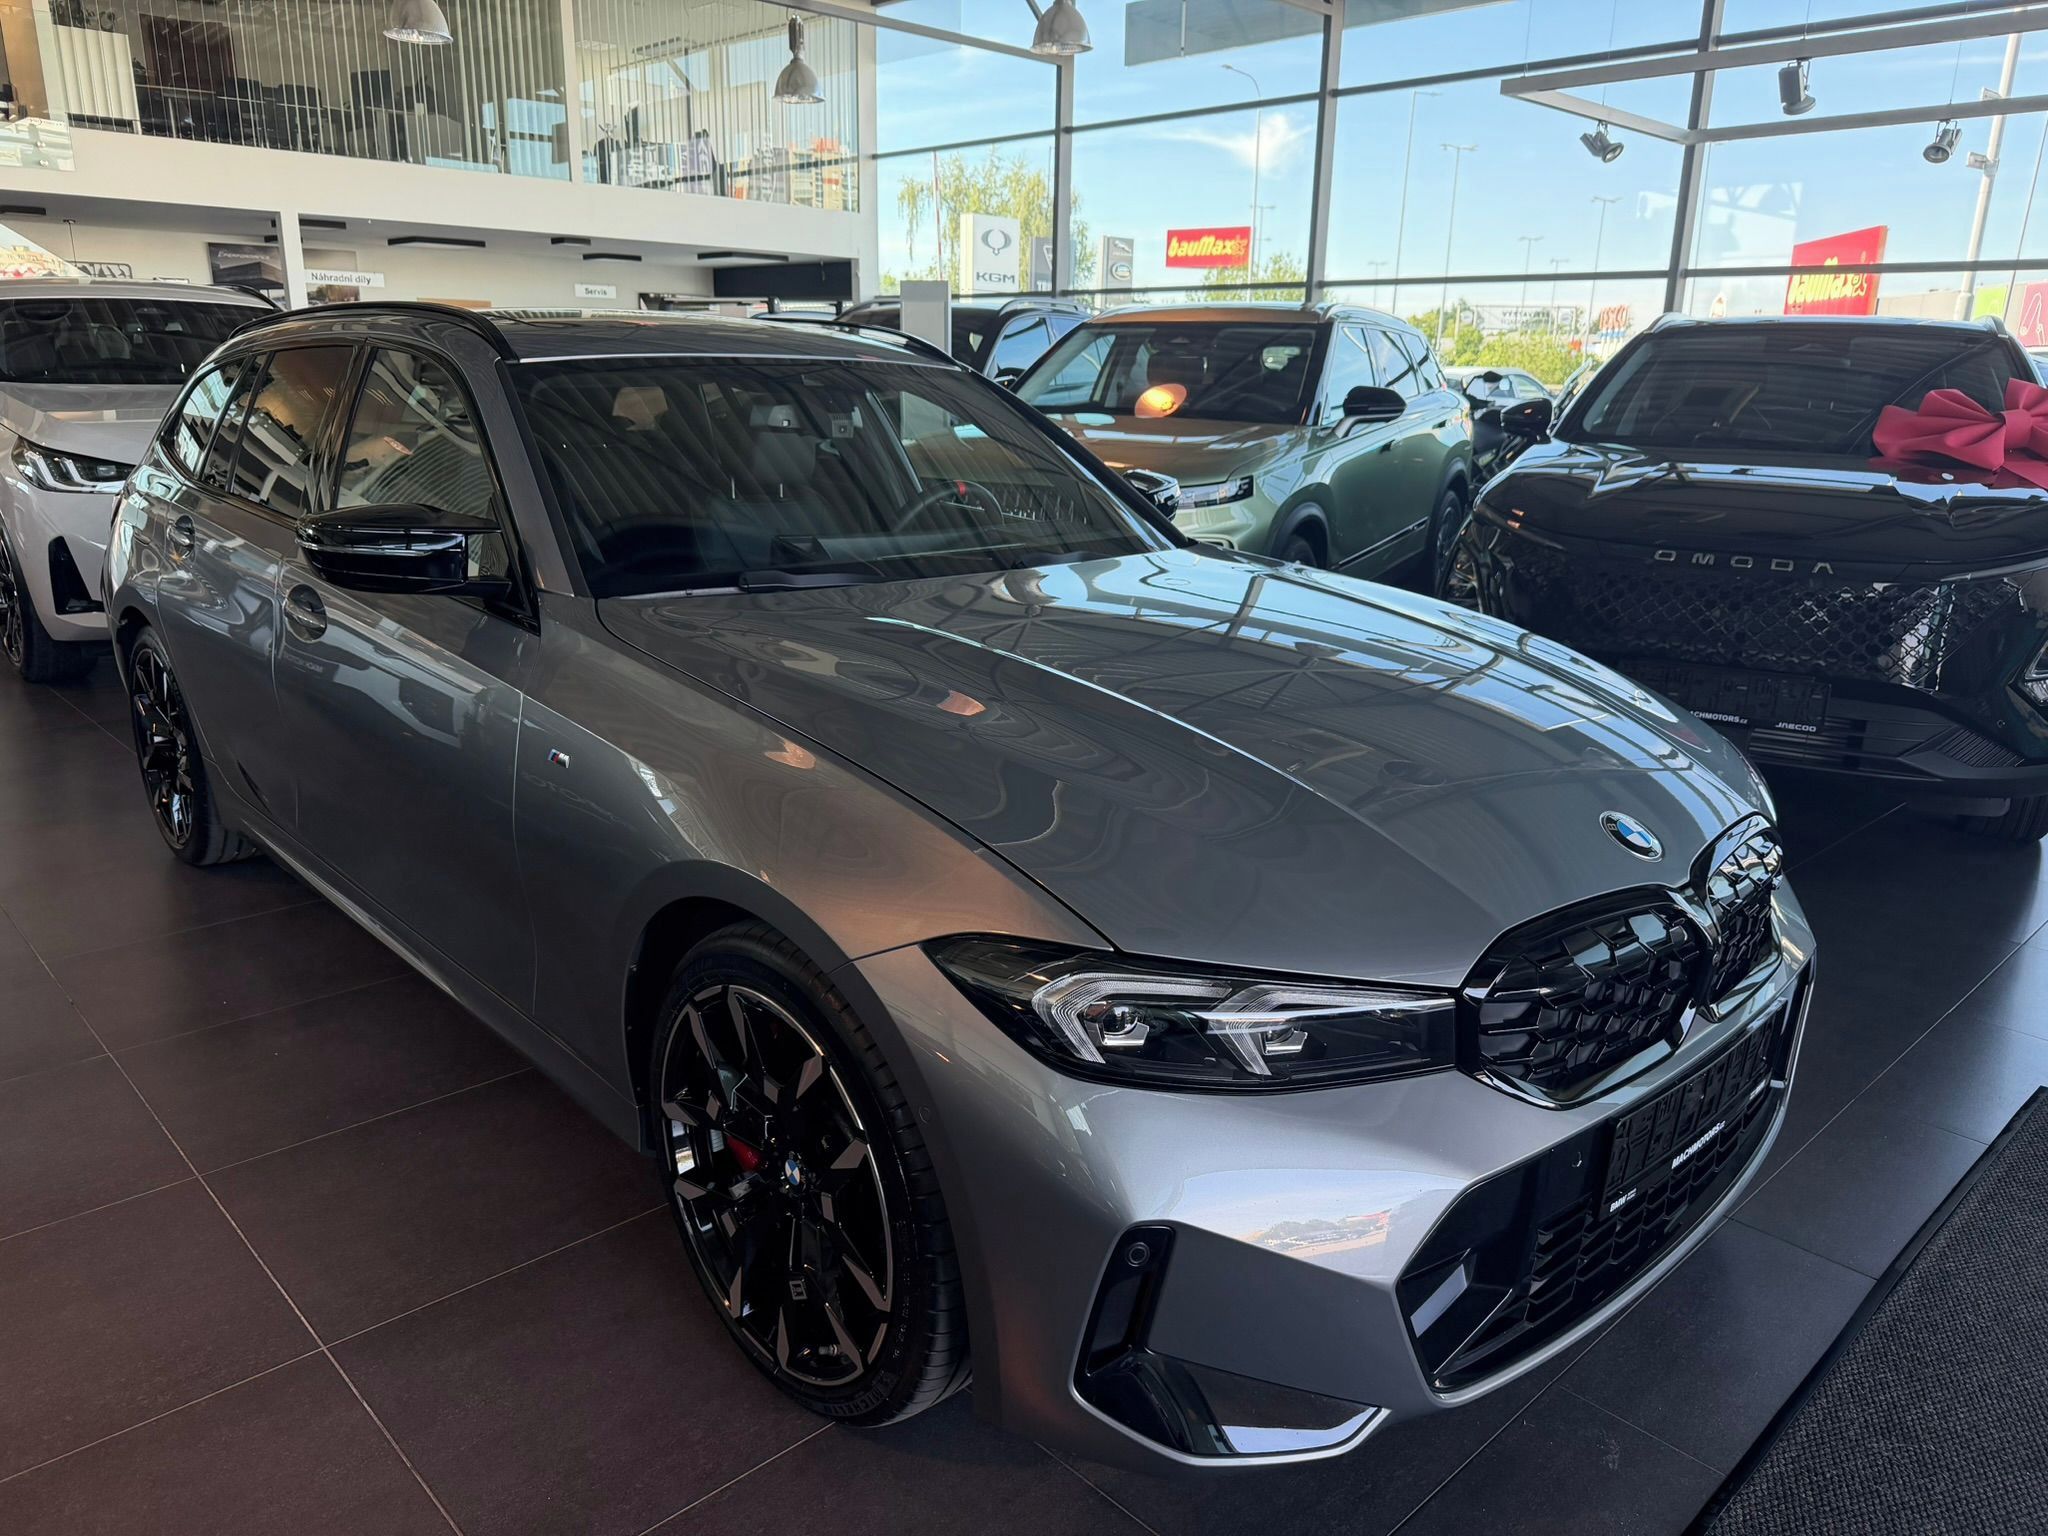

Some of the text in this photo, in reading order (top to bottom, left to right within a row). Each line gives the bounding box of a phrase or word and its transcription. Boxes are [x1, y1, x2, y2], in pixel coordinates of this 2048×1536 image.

[311, 272, 353, 283] Náhradní
[976, 271, 1015, 284] KGM
[584, 287, 607, 296] Servis
[1654, 549, 1834, 574] OMODA
[1775, 721, 1817, 733] JAECOO
[1609, 1194, 1627, 1213] BMW
